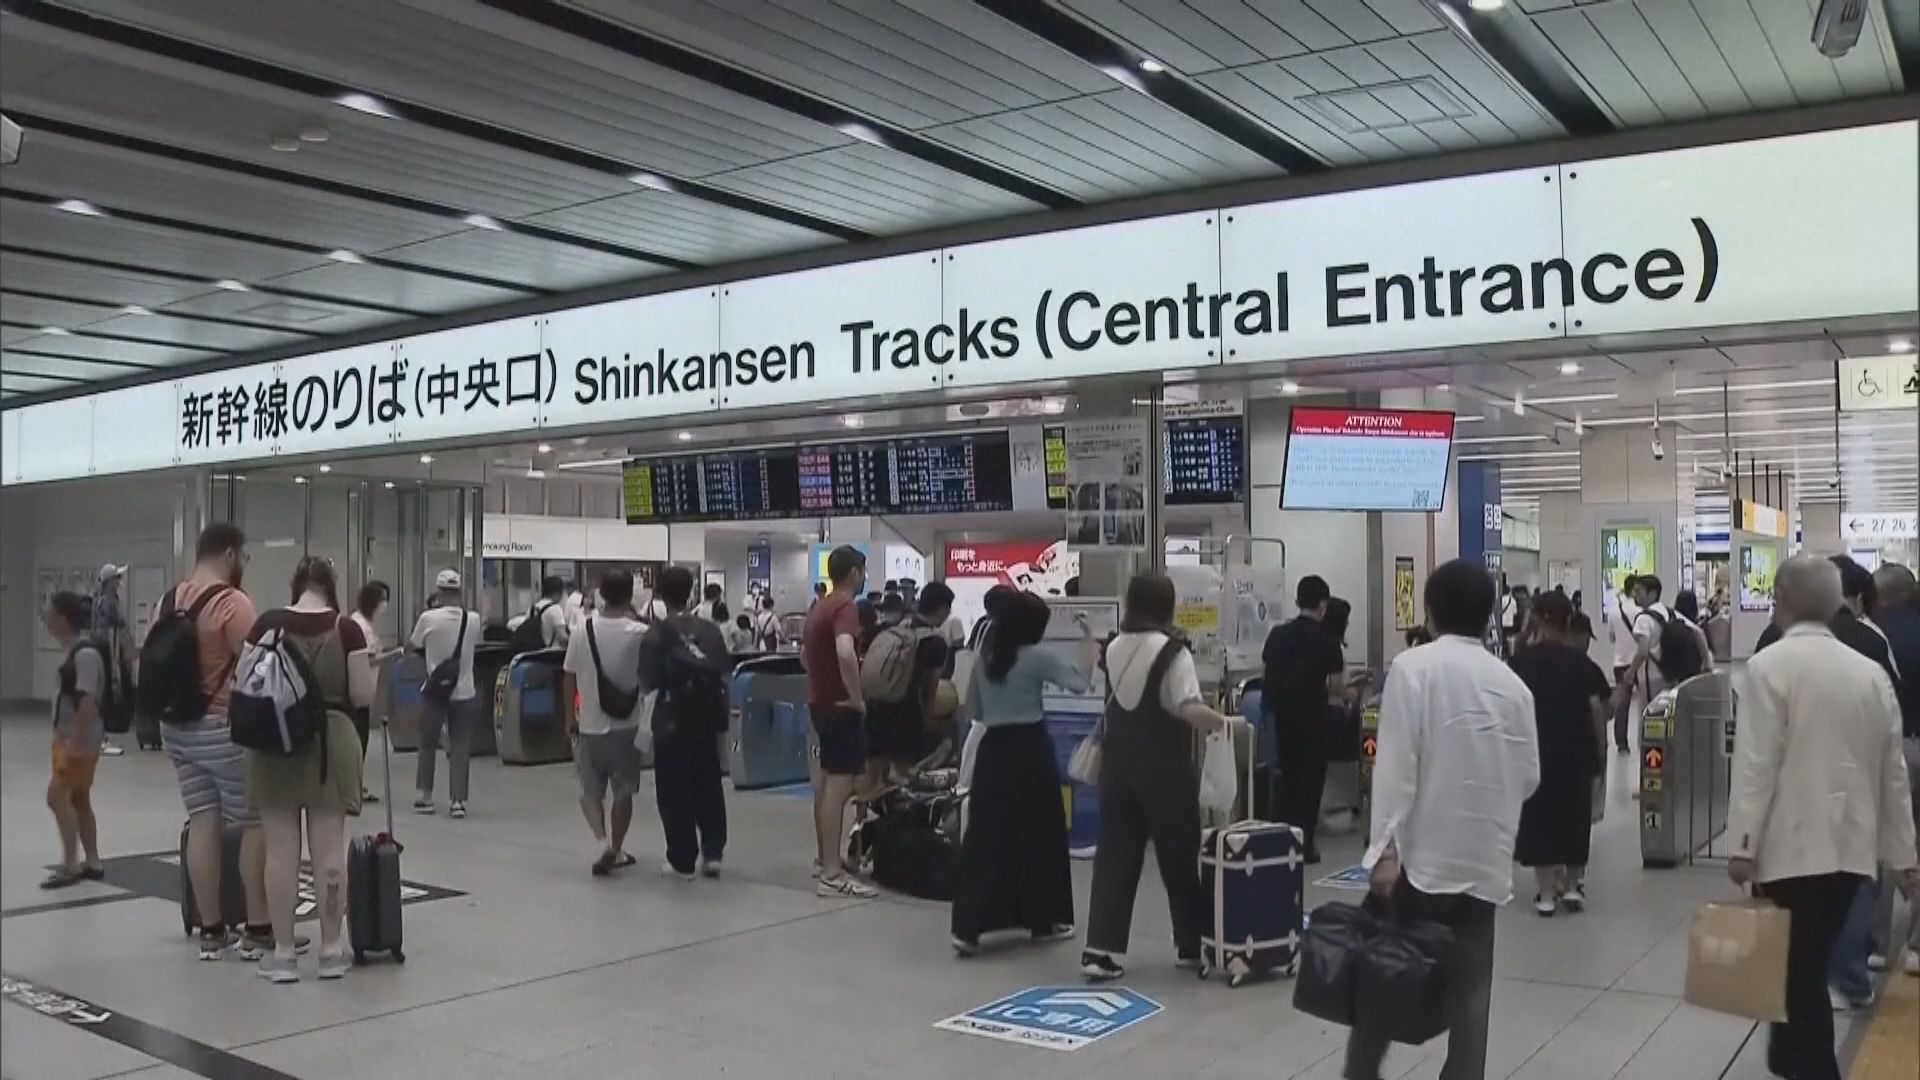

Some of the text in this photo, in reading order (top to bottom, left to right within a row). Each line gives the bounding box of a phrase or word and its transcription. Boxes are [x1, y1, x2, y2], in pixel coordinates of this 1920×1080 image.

[181, 216, 1720, 449] 新幹線のりば(中央口) Shinkansen Tracks (Central Entrance)
[1344, 415, 1404, 428] ATTENTION
[1871, 518, 1886, 532] 27
[483, 542, 533, 553] moking Room
